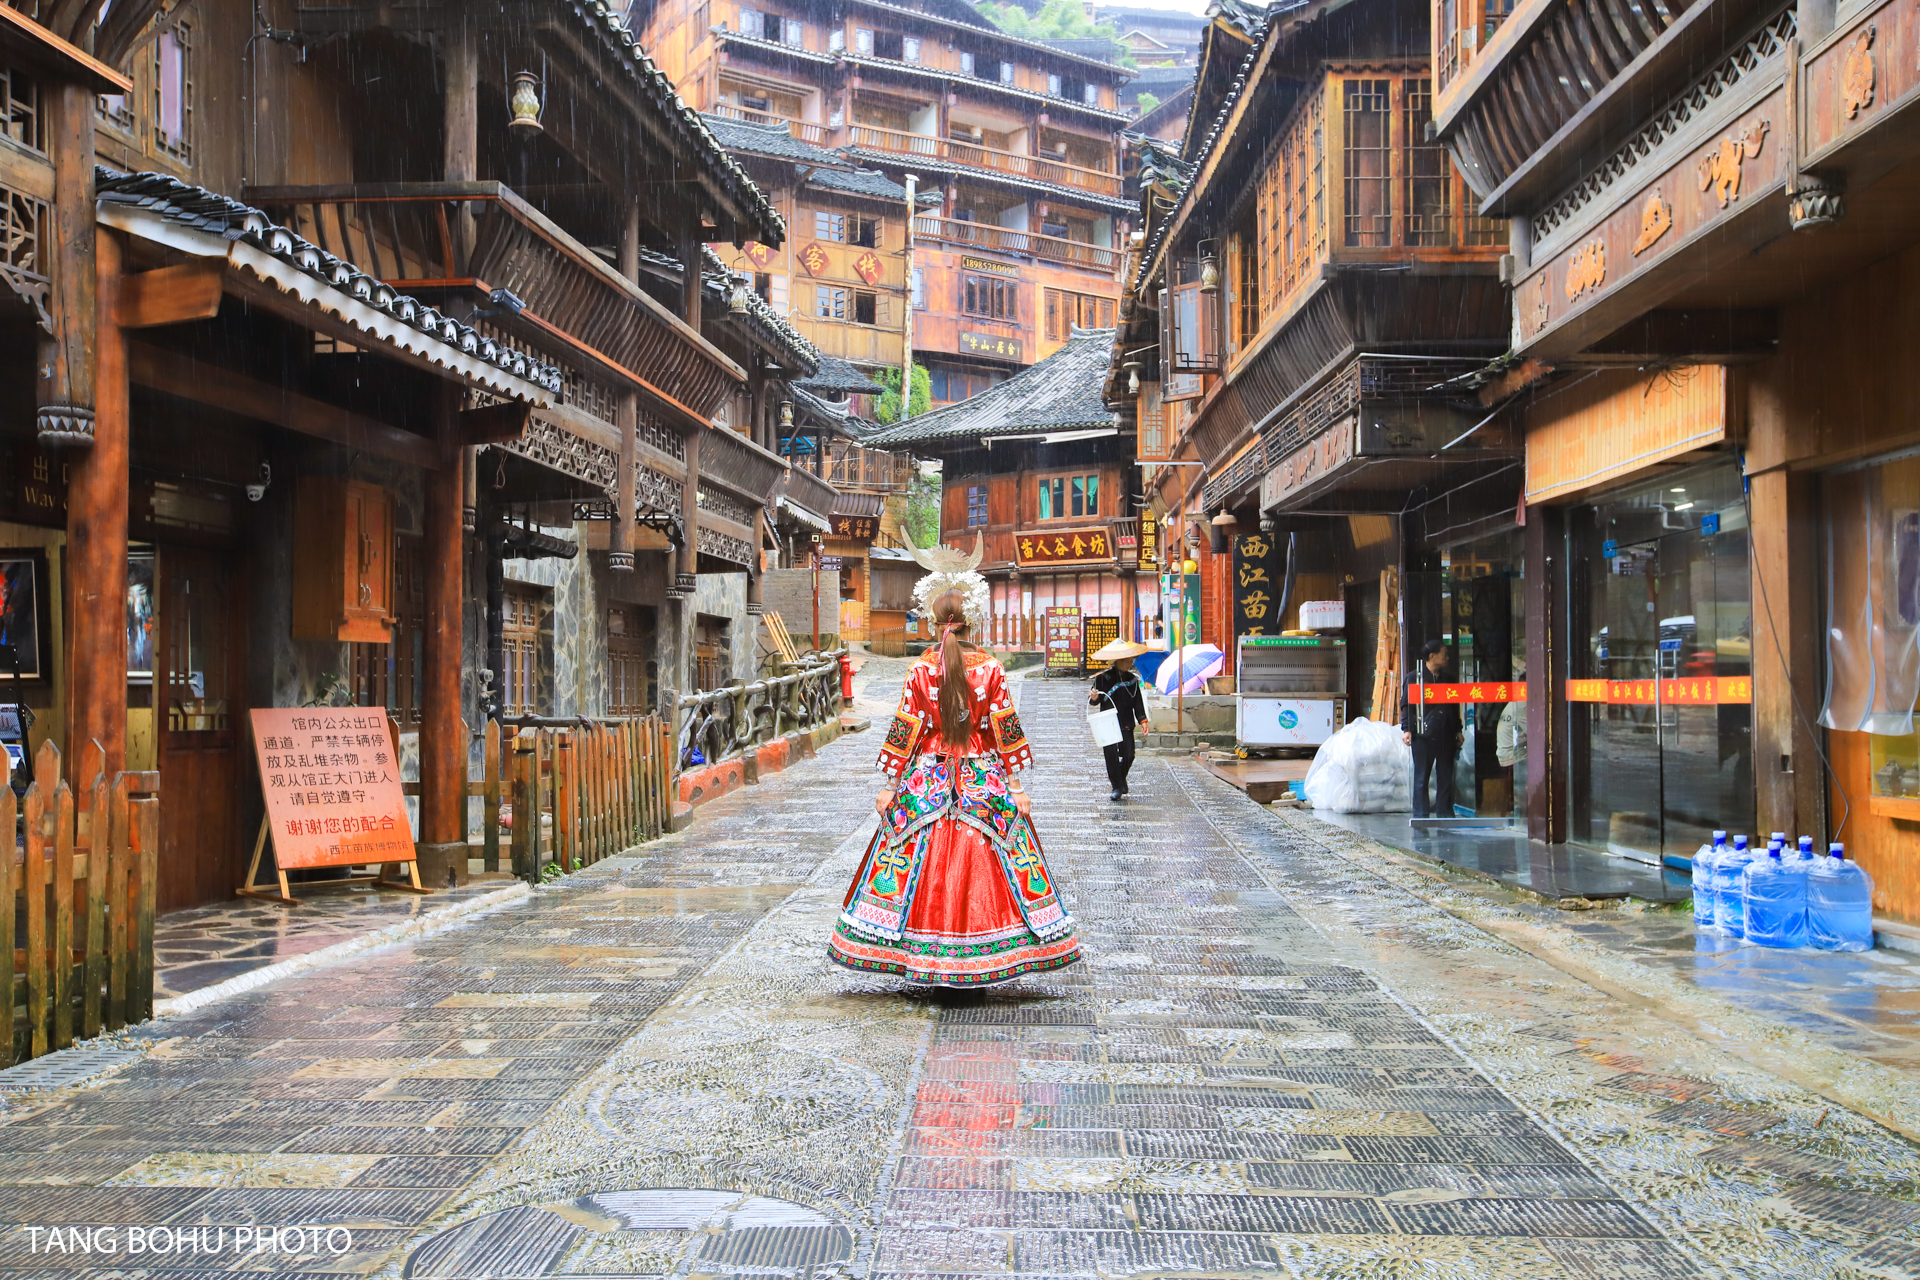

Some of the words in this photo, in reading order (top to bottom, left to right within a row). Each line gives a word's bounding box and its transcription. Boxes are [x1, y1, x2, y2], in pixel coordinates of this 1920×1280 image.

[966, 259, 1016, 275] 18985280098
[25, 486, 56, 512] Way
[1020, 534, 1105, 559] 苗人谷食坊
[1423, 684, 1508, 701] 西江饭店
[1613, 682, 1656, 701] 西江饭店
[1667, 680, 1712, 701] 西江饭店
[1728, 681, 1752, 698] 欢迎
[291, 716, 382, 731] 馆内公众出口
[266, 752, 389, 769] 放及乱堆杂物。参
[269, 771, 393, 788] 观从馆正大门进入
[286, 814, 395, 836] 谢谢您的配合
[328, 841, 409, 855] 西江苗族博物馆
